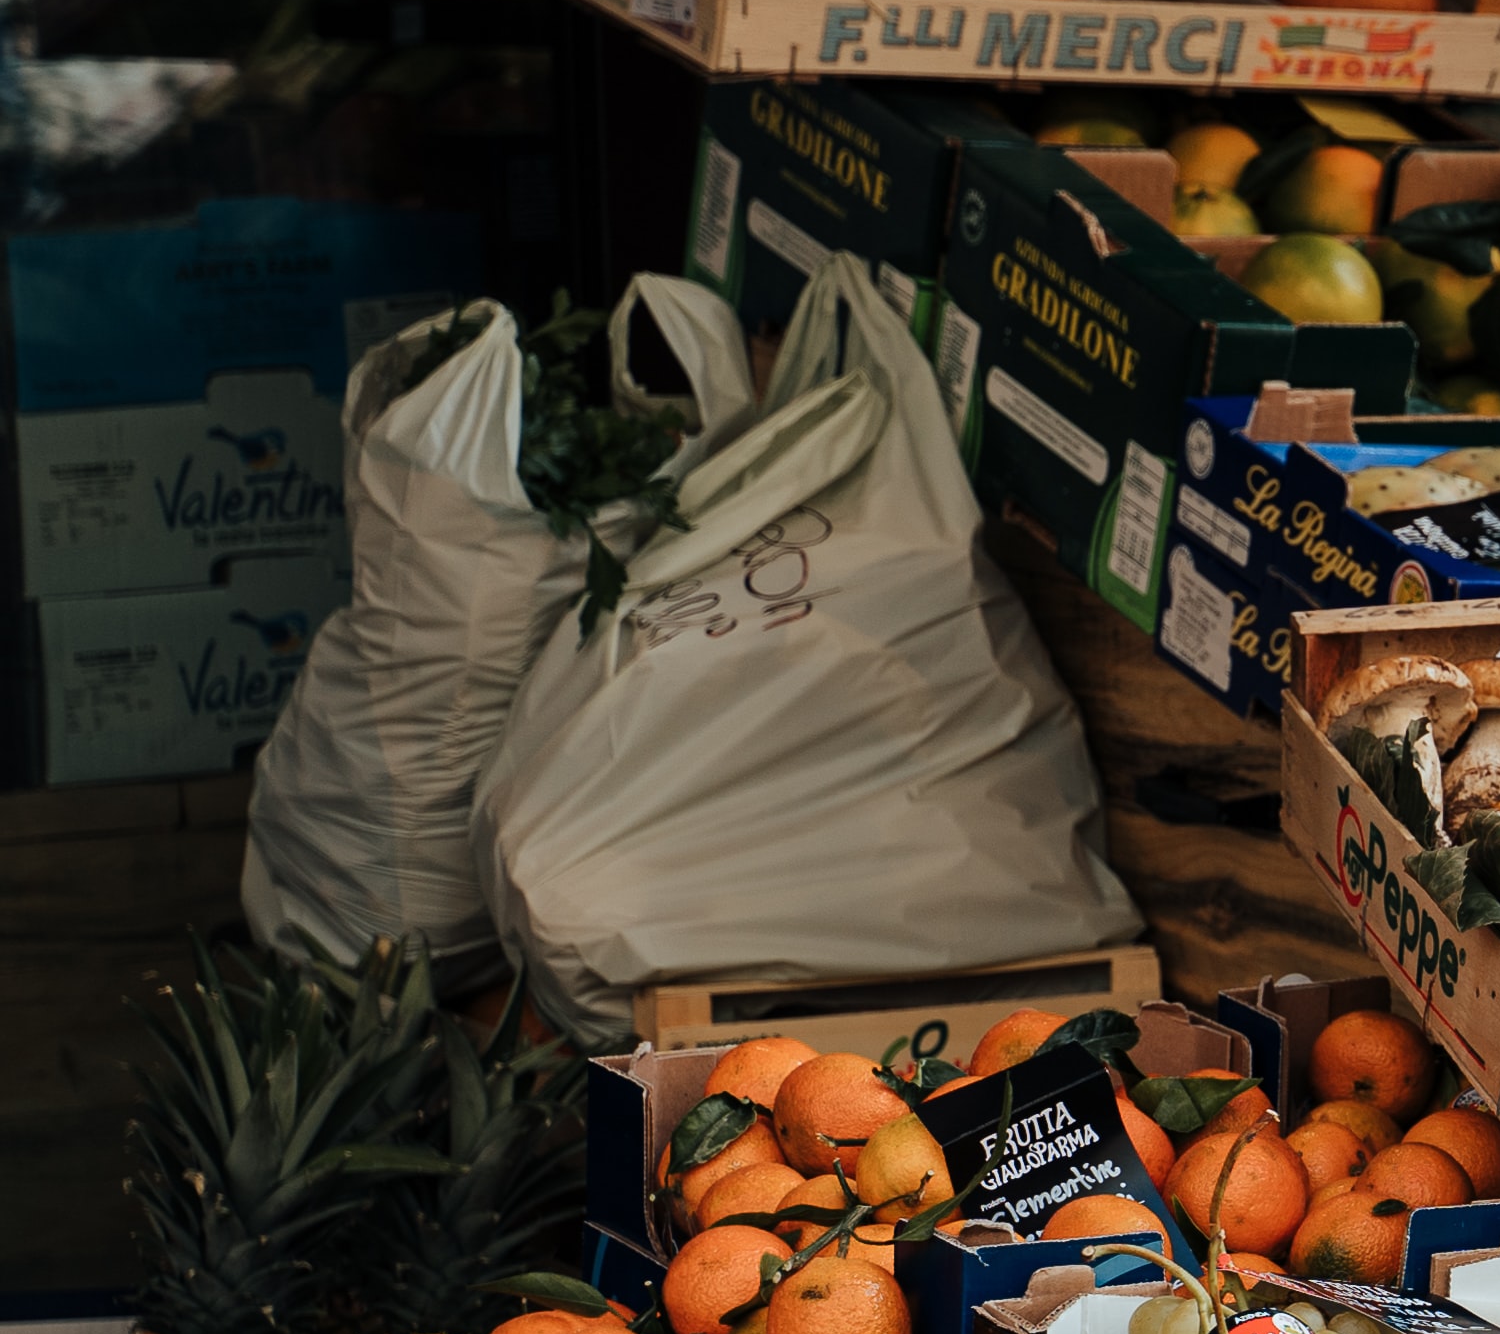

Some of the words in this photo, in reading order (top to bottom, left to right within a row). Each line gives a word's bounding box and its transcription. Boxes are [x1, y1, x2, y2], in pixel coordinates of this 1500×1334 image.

[976, 11, 1246, 75] MERCI
[749, 87, 892, 212] GRADILONE
[991, 250, 1140, 389] GRADILONE
[1232, 463, 1283, 533] La
[979, 1101, 1077, 1162] FRUTTA
[990, 1158, 1122, 1225] Clementine
